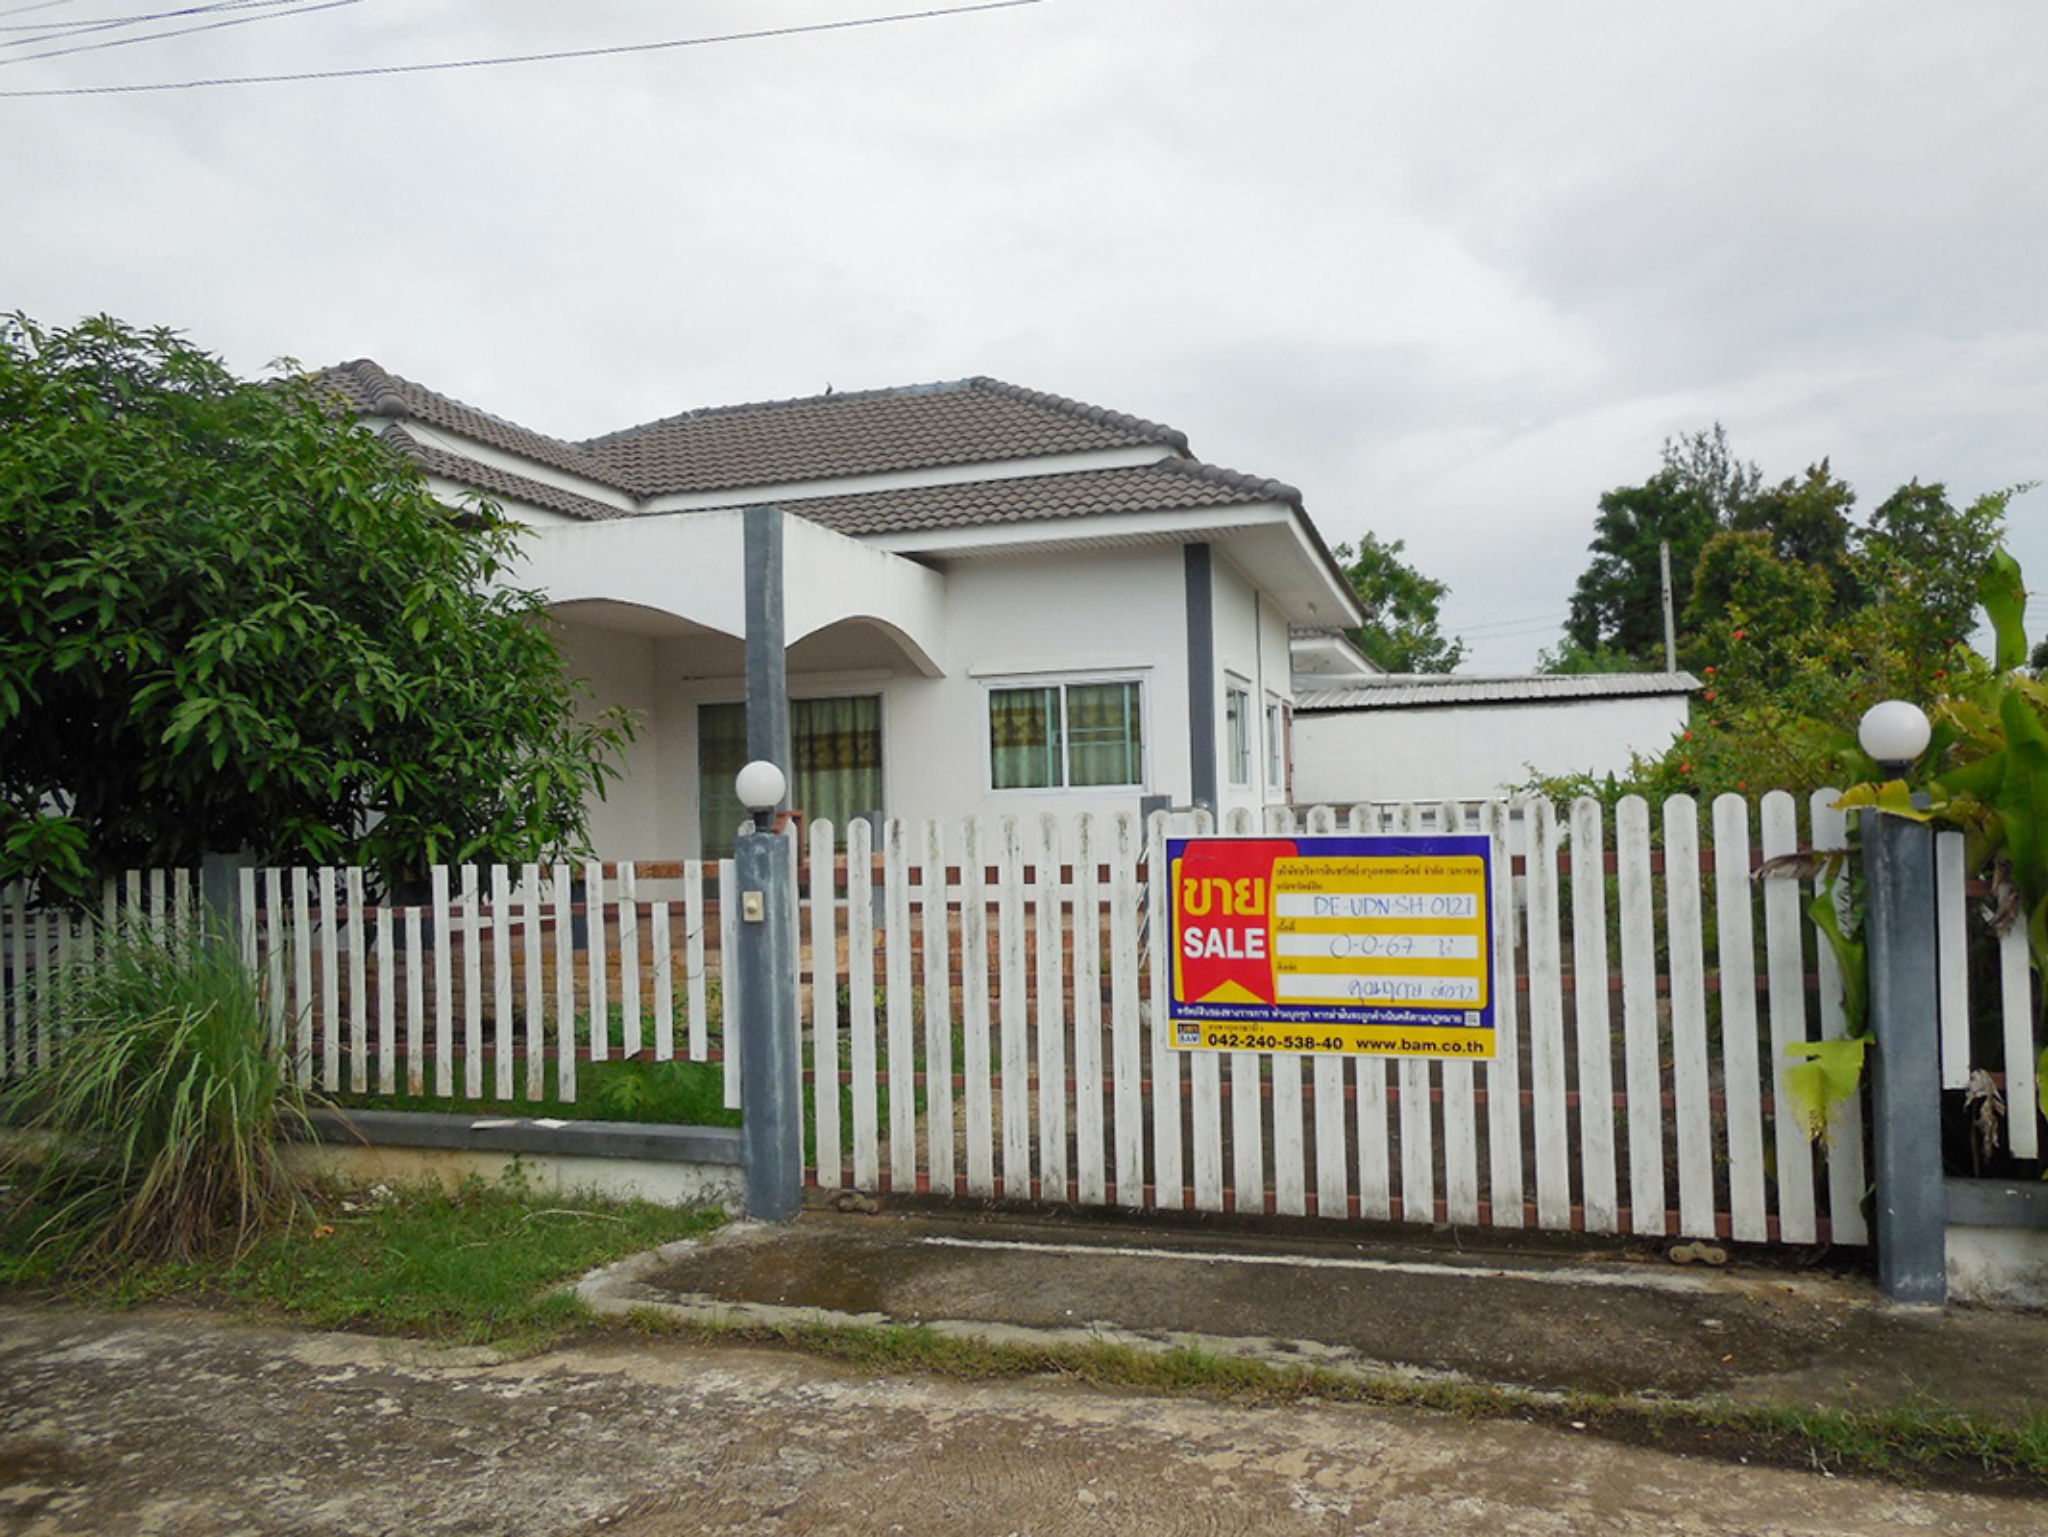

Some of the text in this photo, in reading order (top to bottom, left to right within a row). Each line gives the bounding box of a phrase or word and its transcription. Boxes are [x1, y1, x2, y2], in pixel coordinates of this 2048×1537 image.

[1183, 878, 1265, 915] ขาย
[1183, 927, 1265, 959] SALE
[1329, 934, 1415, 959] 0-0-67
[1208, 1033, 1484, 1053] 042-240-538-40 www.bam.co.th
